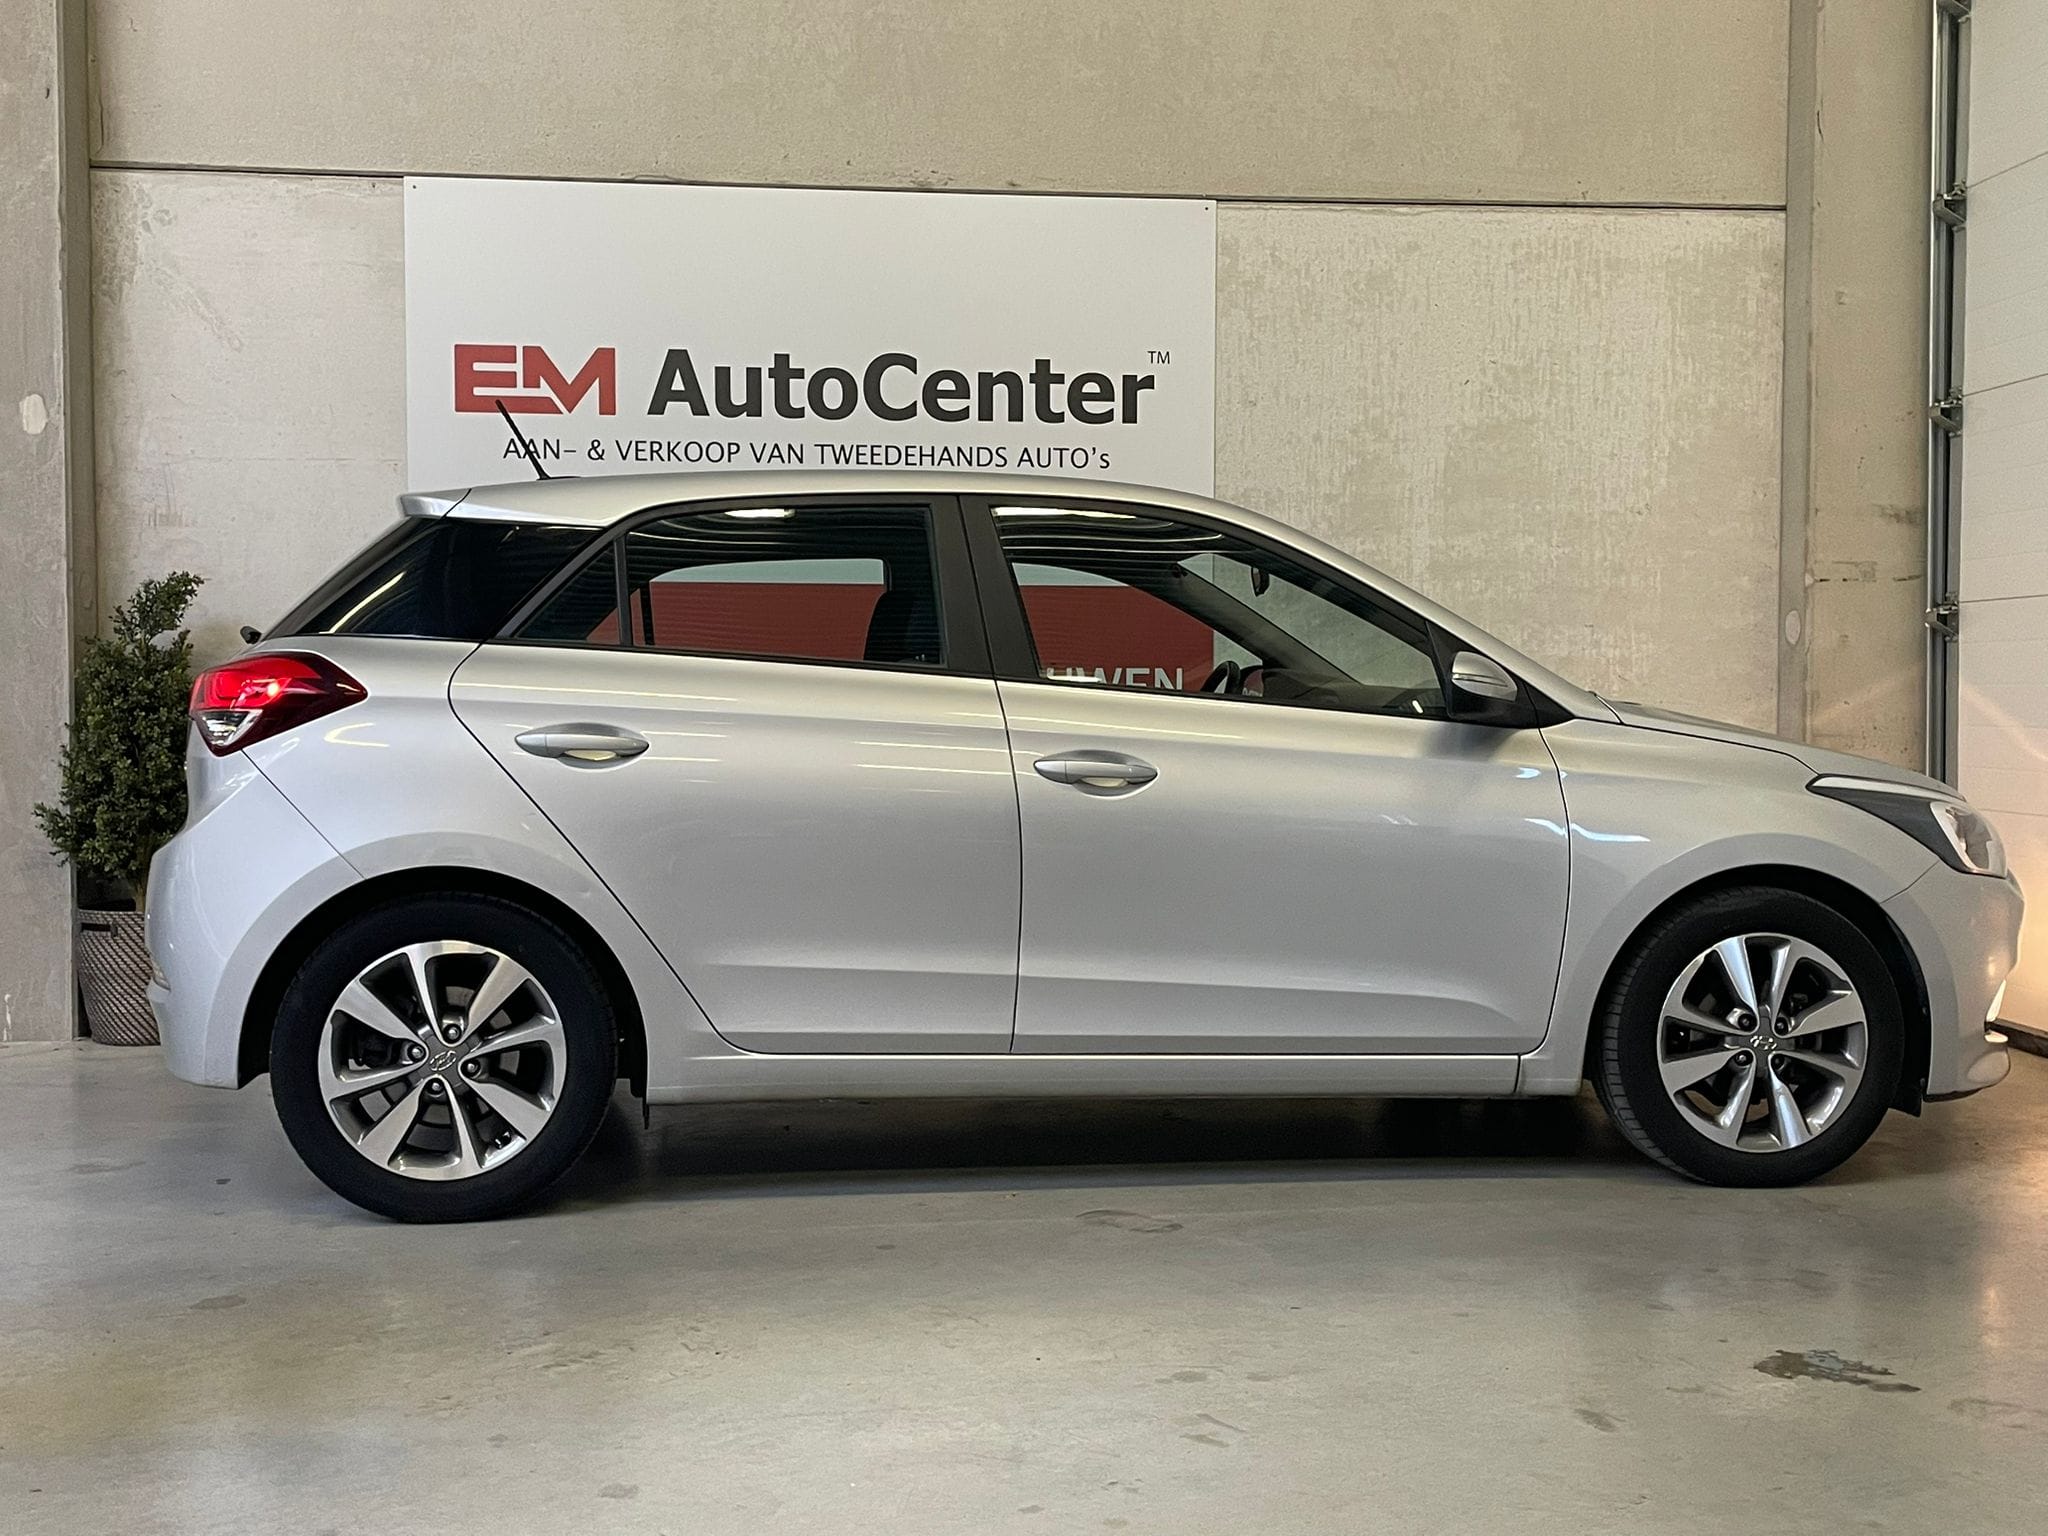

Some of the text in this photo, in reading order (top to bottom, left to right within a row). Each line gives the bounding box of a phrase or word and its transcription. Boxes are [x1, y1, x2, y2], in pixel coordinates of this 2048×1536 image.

[454, 344, 616, 415] EM
[647, 348, 1155, 424] AutoCenter
[587, 439, 606, 461] &
[615, 440, 741, 463] VERKOOP
[750, 442, 804, 464] VAN
[814, 444, 1008, 468] TWEEDEHANDS
[1017, 447, 1110, 469] AUTO's
